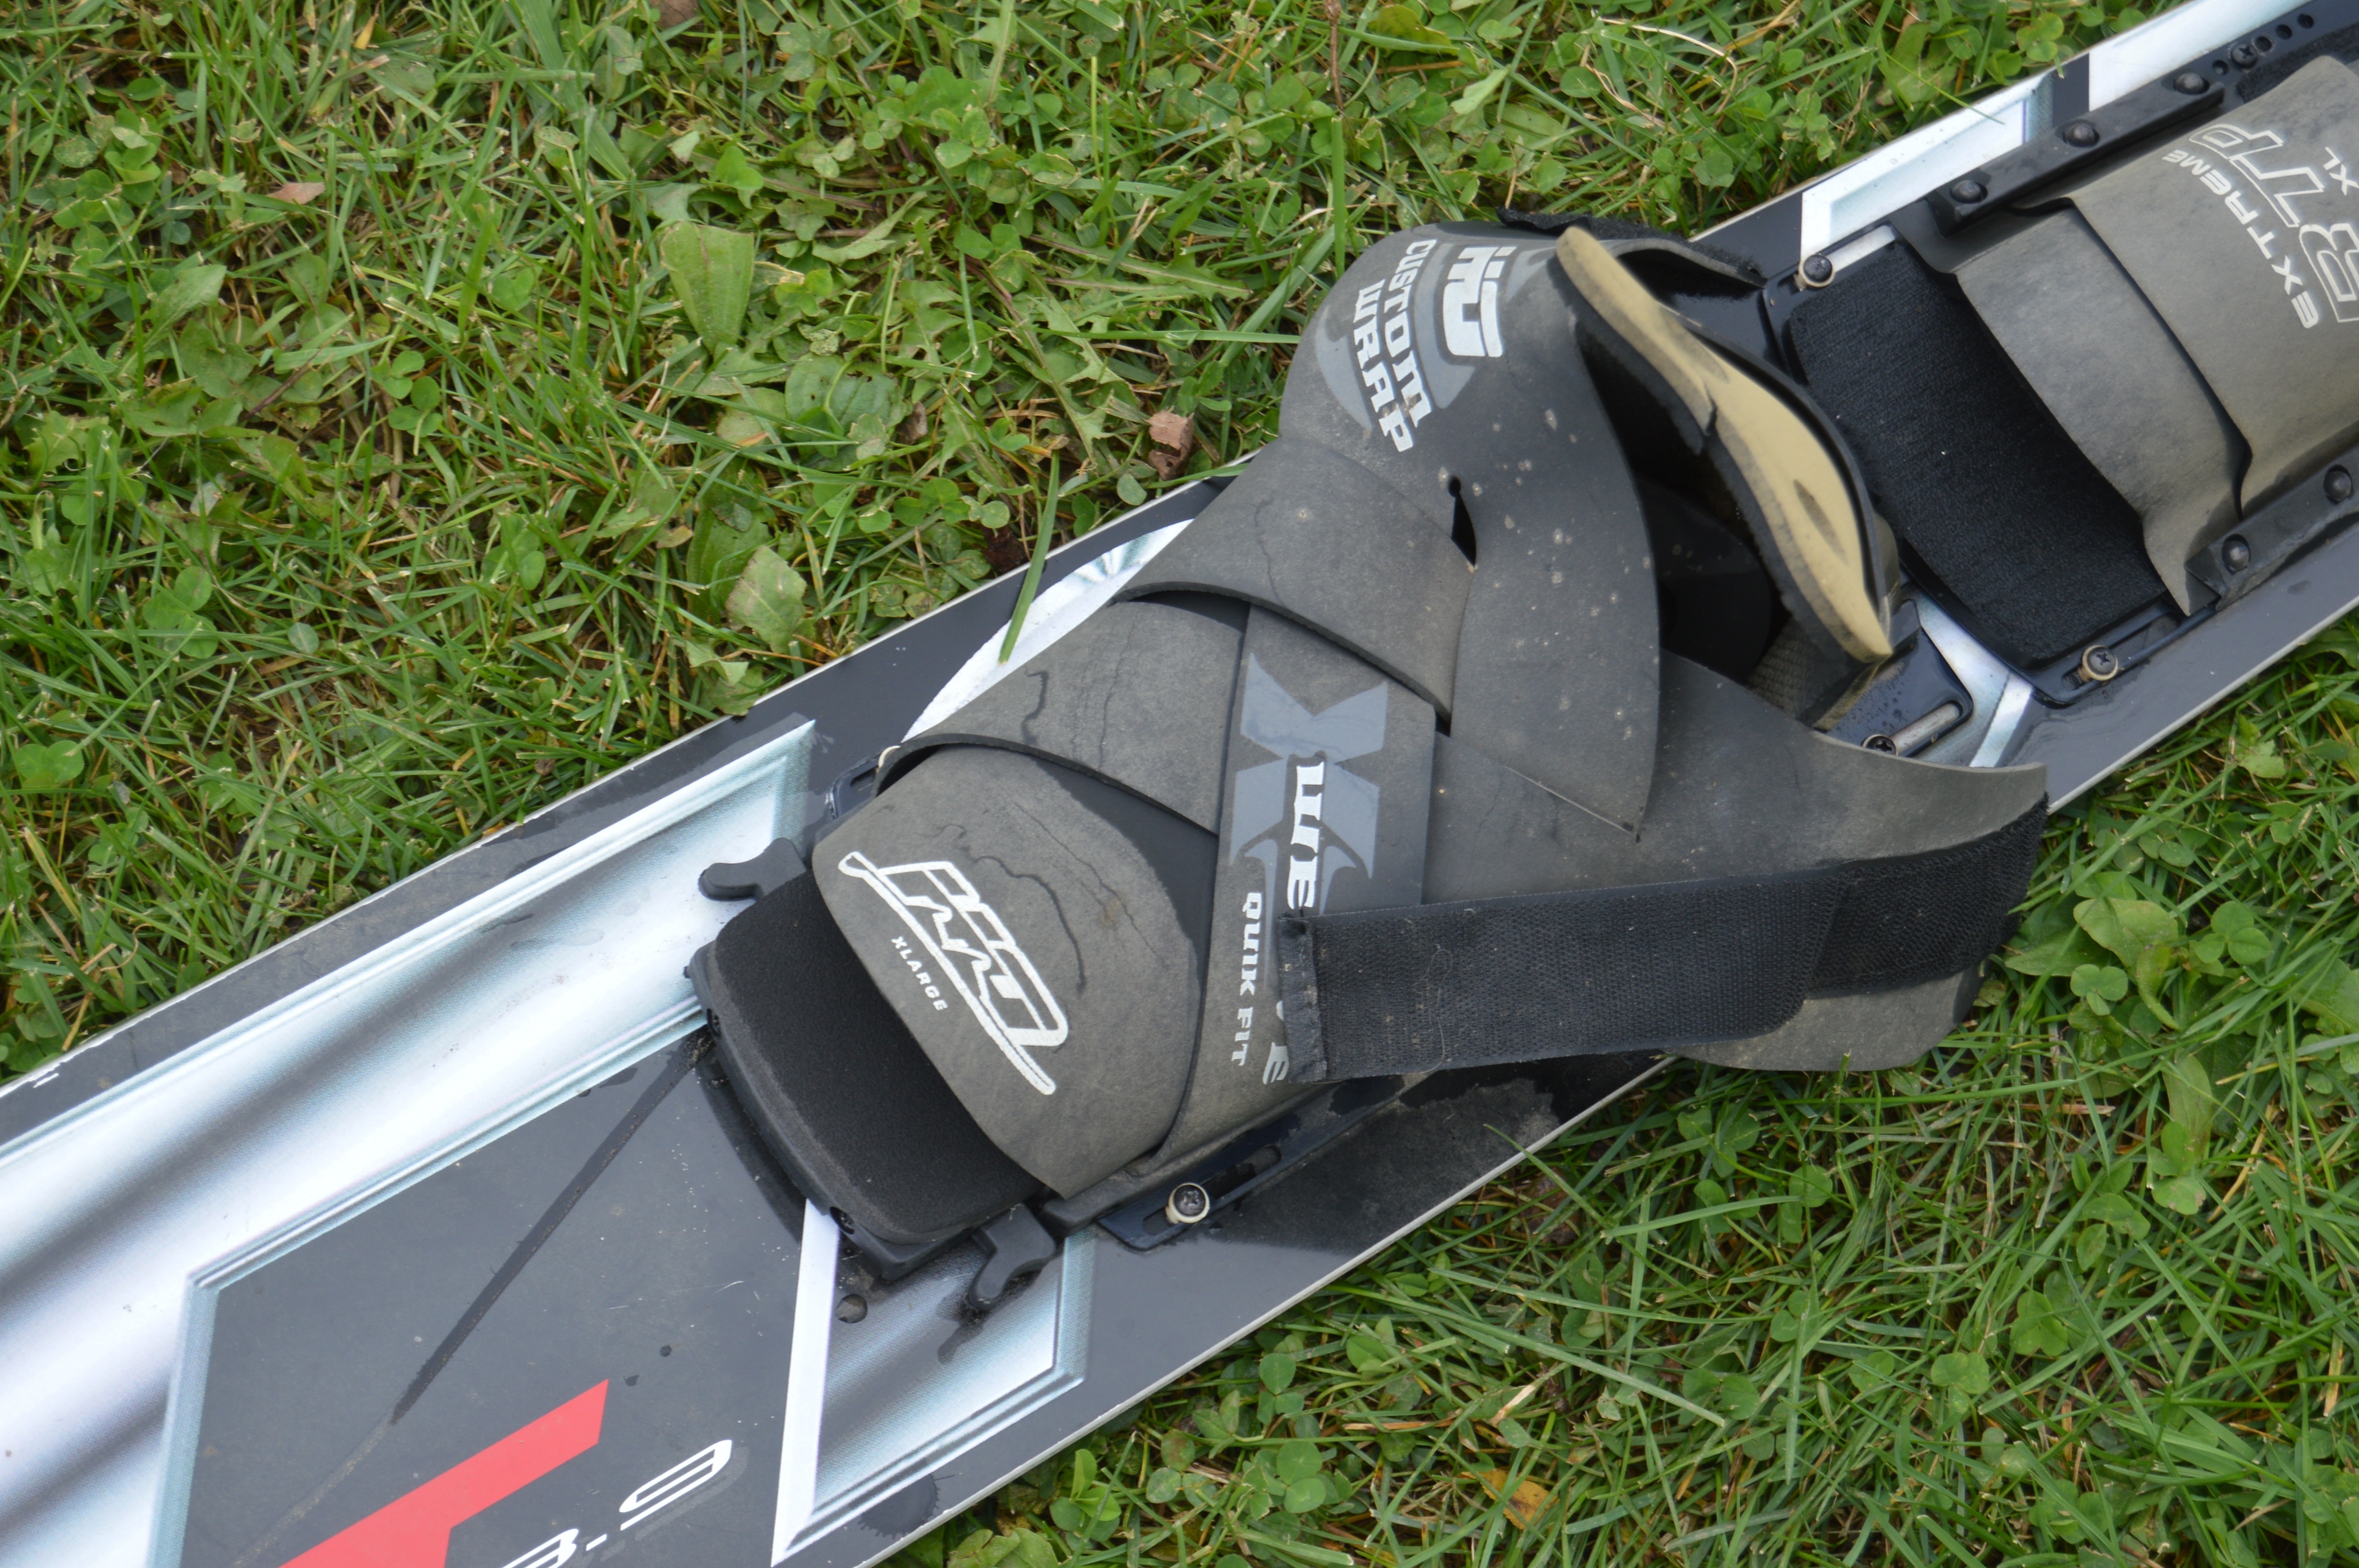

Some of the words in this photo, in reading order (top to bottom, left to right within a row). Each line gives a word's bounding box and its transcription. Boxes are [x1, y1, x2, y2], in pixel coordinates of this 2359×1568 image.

[2323, 146, 2359, 196] XL
[2162, 149, 2318, 328] EXTREME
[1353, 279, 1414, 453] WRAP
[1384, 239, 1436, 428] CUSTOM
[891, 936, 948, 1011] XLARGE
[1240, 892, 1262, 997] QUIK
[1231, 1006, 1254, 1067] FIT
